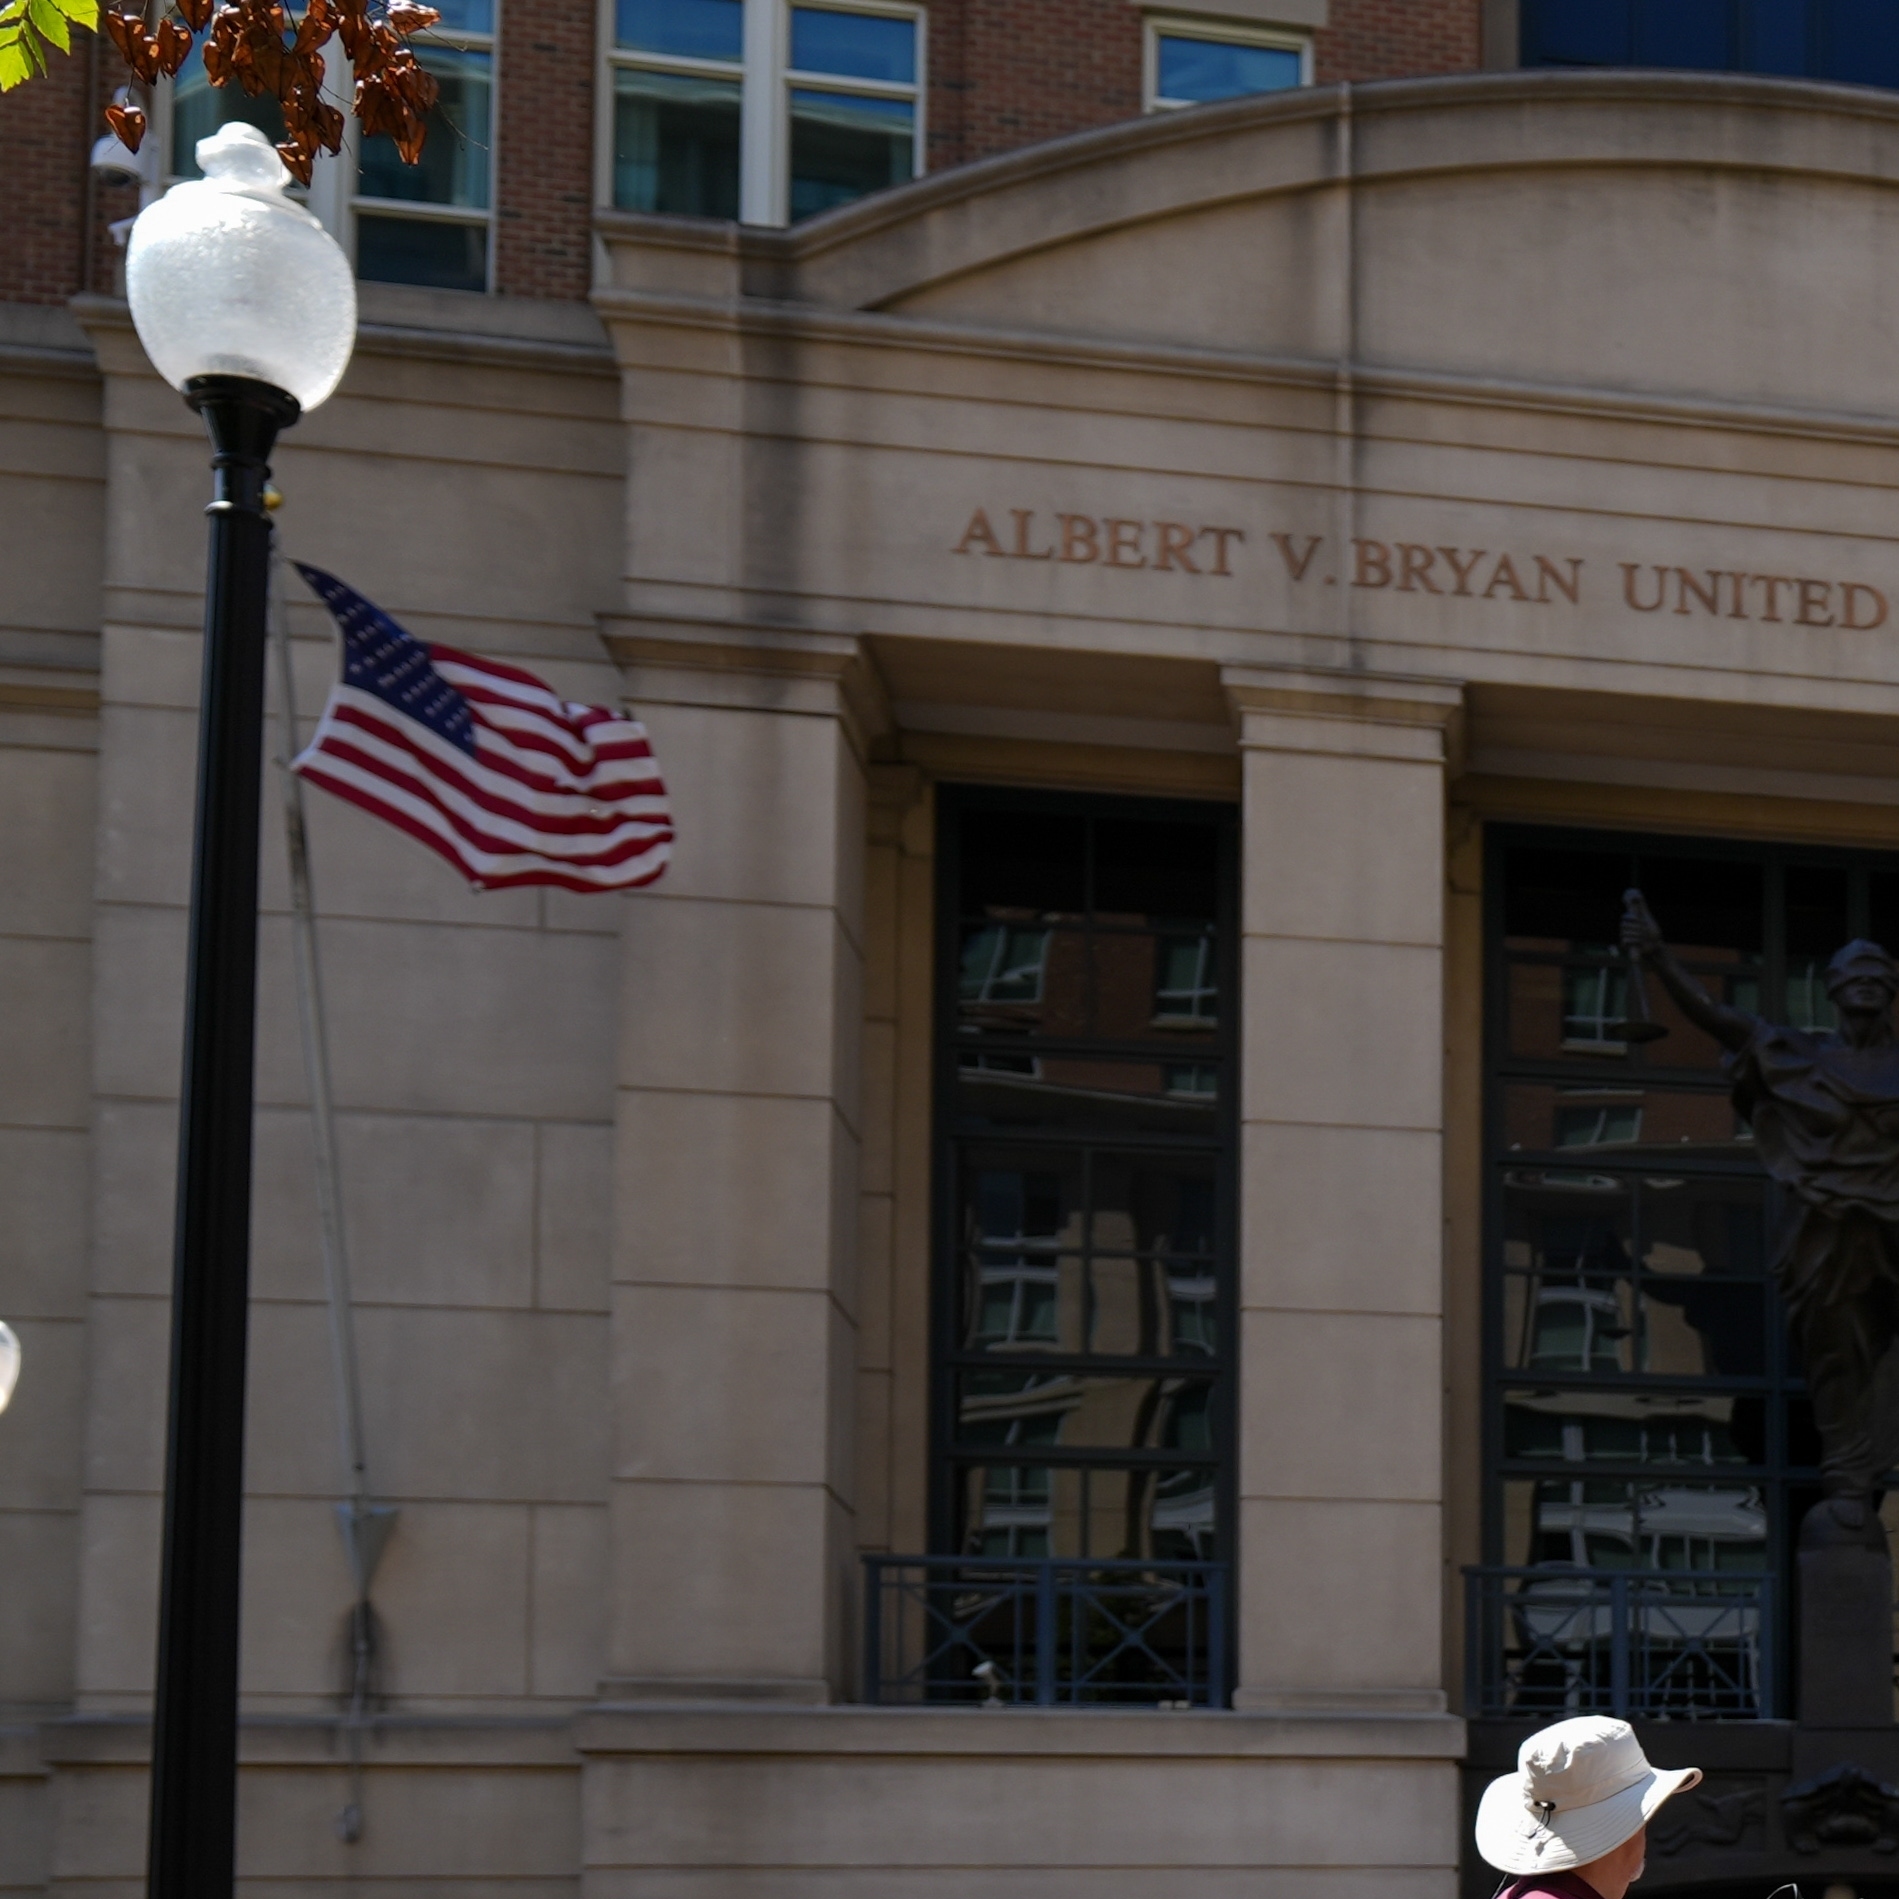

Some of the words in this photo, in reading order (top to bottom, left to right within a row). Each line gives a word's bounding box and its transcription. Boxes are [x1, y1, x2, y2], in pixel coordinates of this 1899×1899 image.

[952, 506, 1245, 578] ALBERT
[1270, 532, 1337, 586] V.
[1350, 538, 1583, 606] BRYAN
[1618, 560, 1888, 632] UNITED
